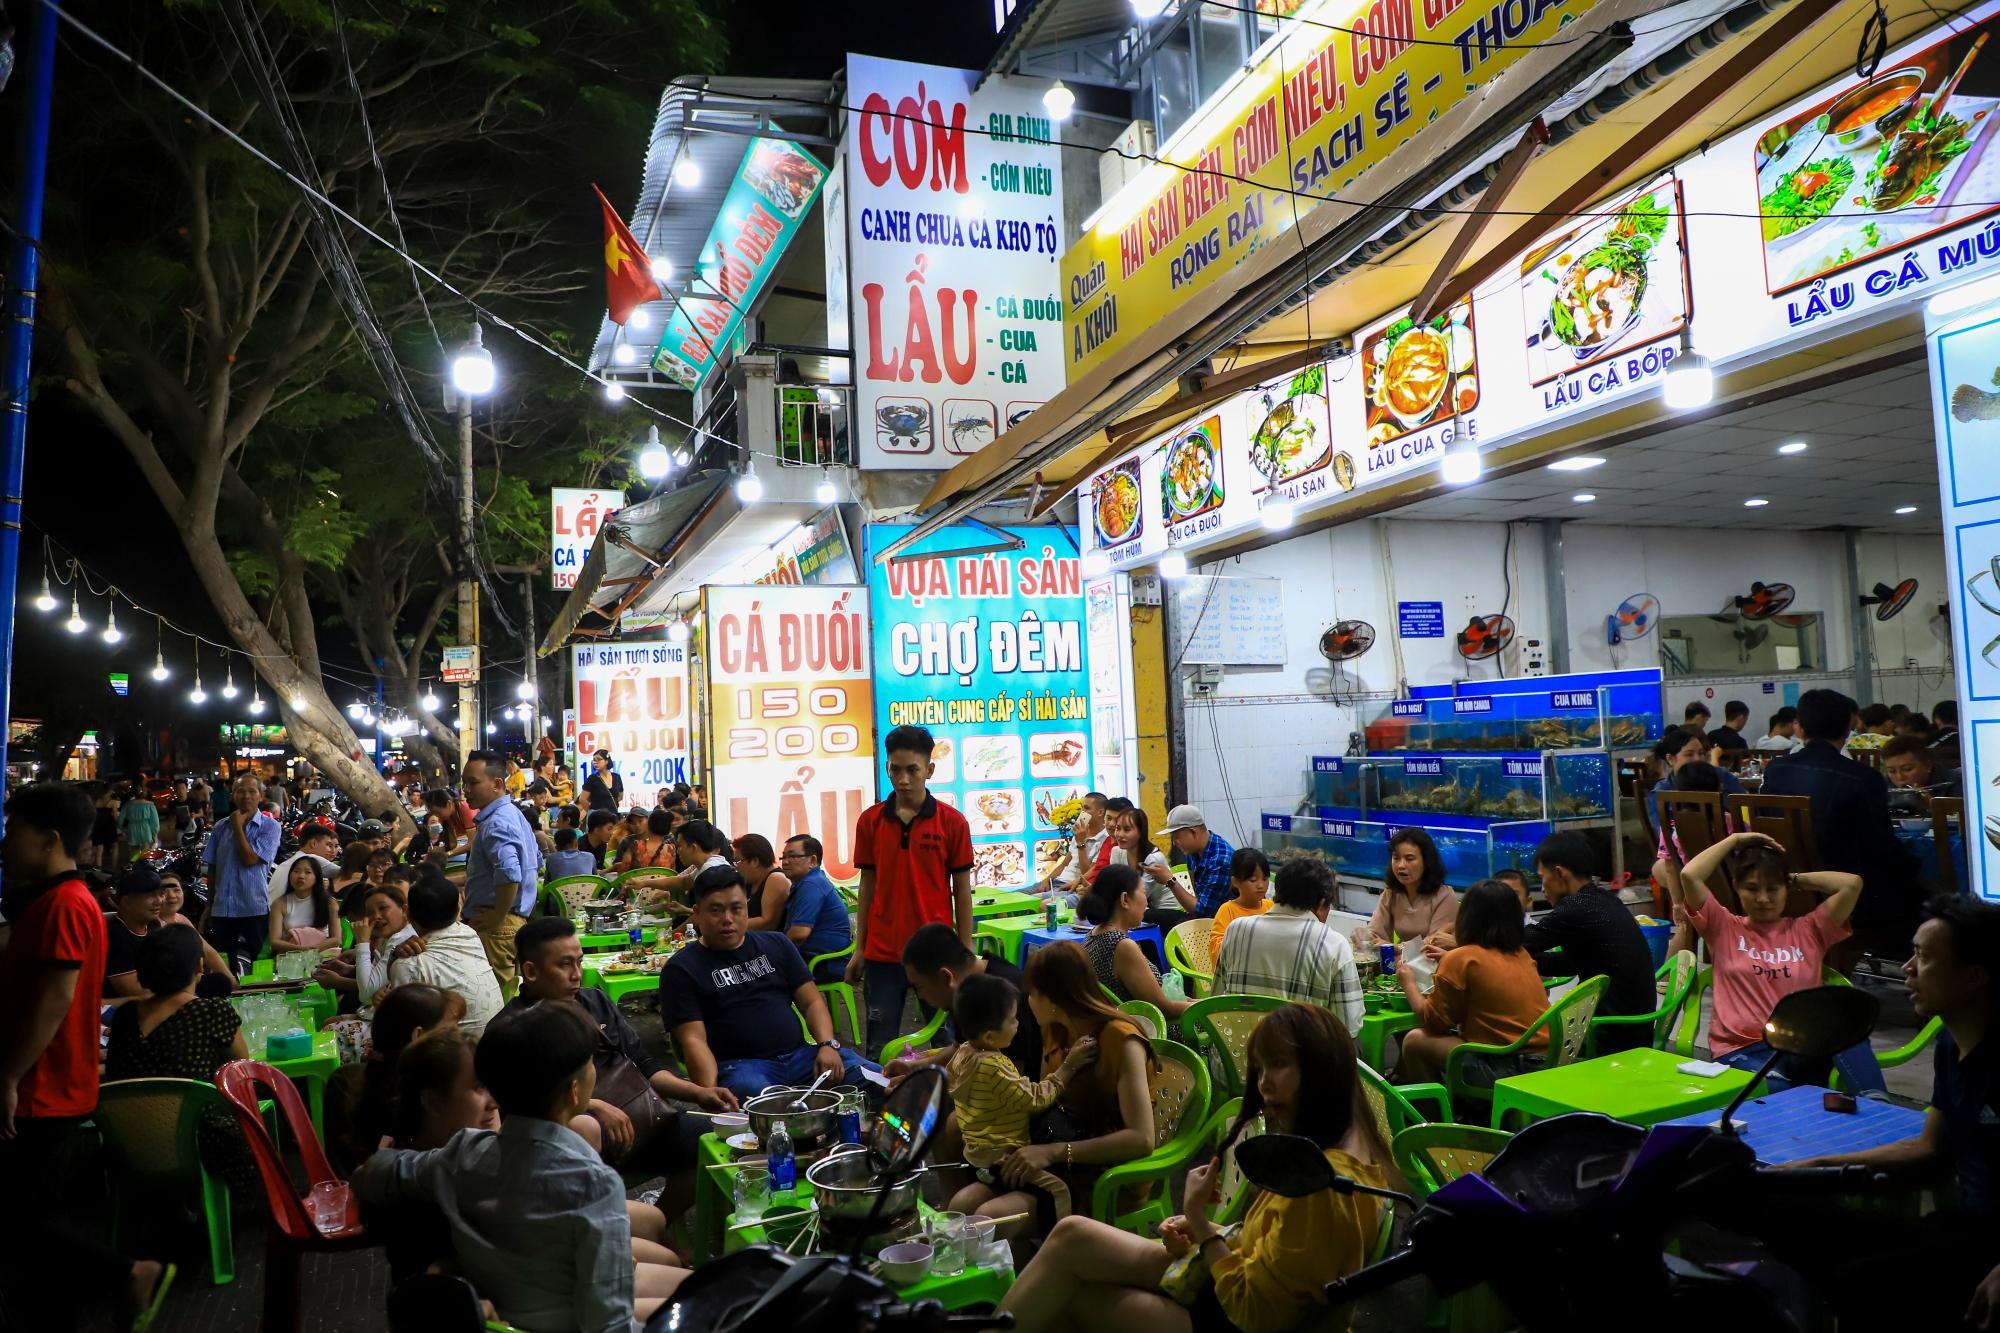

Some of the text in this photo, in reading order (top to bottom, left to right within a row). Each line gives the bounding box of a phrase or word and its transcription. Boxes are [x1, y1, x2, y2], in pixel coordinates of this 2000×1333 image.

[859, 80, 969, 194] CƠM
[989, 112, 1051, 146] GIA ĐÌNH
[1232, 96, 1281, 185] CƠM
[990, 160, 1053, 196] CƠM NIÊU
[1170, 226, 1220, 291] RỘNG
[1227, 190, 1265, 248] RÃI
[1292, 110, 1365, 196] SẠCH
[1374, 72, 1412, 140] SẼ
[734, 203, 784, 267] ĐÊM
[861, 207, 1057, 262] CANH CHUA CÁ KHO TỘ
[1071, 259, 1107, 307] Quán
[1788, 278, 1854, 326] LẨU
[1864, 252, 1928, 298] CÁ
[862, 253, 978, 385] LẨU
[996, 293, 1062, 321] CÁ ĐUỐI
[1000, 329, 1037, 352] CUA
[1074, 292, 1119, 364] A KHÔI
[1002, 359, 1027, 383] CÁ
[1544, 345, 1676, 411] LẨU CÁ BỚP
[1401, 440, 1435, 461] CUA
[555, 543, 576, 566] CÁ
[1019, 547, 1081, 596] SẢN
[719, 592, 863, 674] CÁ ĐUỐI
[891, 610, 1082, 686] CHỢ ĐÊM
[600, 646, 621, 666] SẢN
[625, 648, 649, 664] TƯƠI
[653, 643, 683, 663] SỐNG
[579, 667, 683, 725] LẨU
[737, 686, 847, 720] 150
[890, 697, 944, 725] CHUYÊN
[948, 699, 985, 723] CUNG
[988, 691, 1015, 722] CẤP
[1035, 689, 1057, 719] HẢI
[1060, 689, 1087, 719] SẢN
[1554, 692, 1593, 706] CUA KING
[729, 723, 859, 759] 200
[643, 757, 686, 784] 200K
[1507, 761, 1522, 775] TÔM
[1268, 817, 1283, 830] GHẸ
[1324, 822, 1335, 834] TÔM
[711, 954, 776, 988] ORIGINAL
